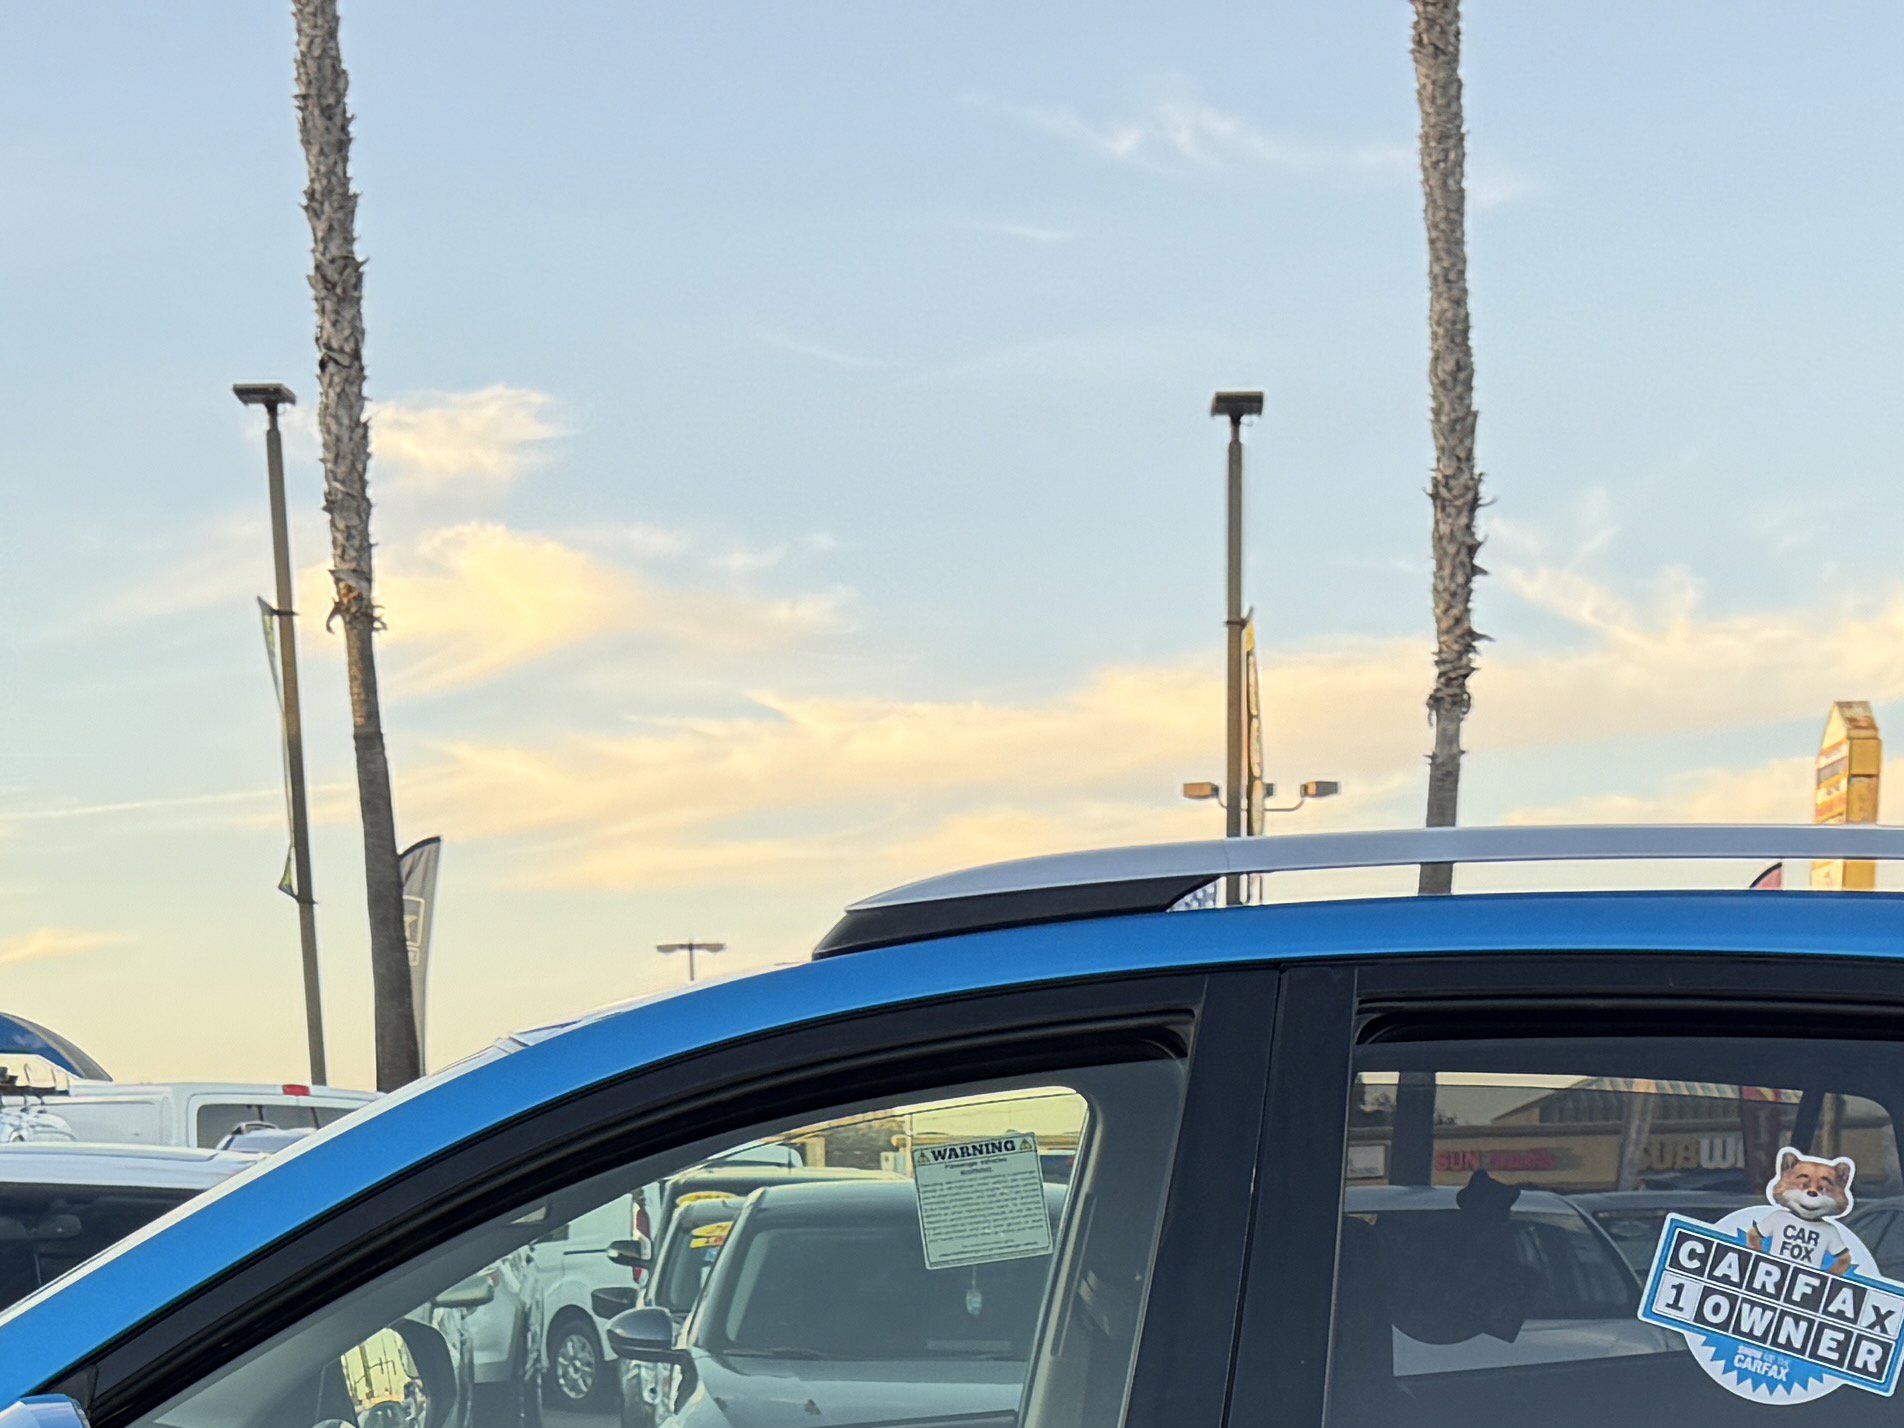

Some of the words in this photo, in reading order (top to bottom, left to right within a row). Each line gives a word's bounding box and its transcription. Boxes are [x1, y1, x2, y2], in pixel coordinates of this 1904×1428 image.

[931, 1140, 1016, 1161] WARNING
[1782, 1225, 1820, 1247] CAR
[1779, 1241, 1814, 1263] FOX
[1677, 1240, 1897, 1336] CARFAX
[1702, 1294, 1884, 1373] OWNER
[1733, 1354, 1790, 1382] CARFAX
